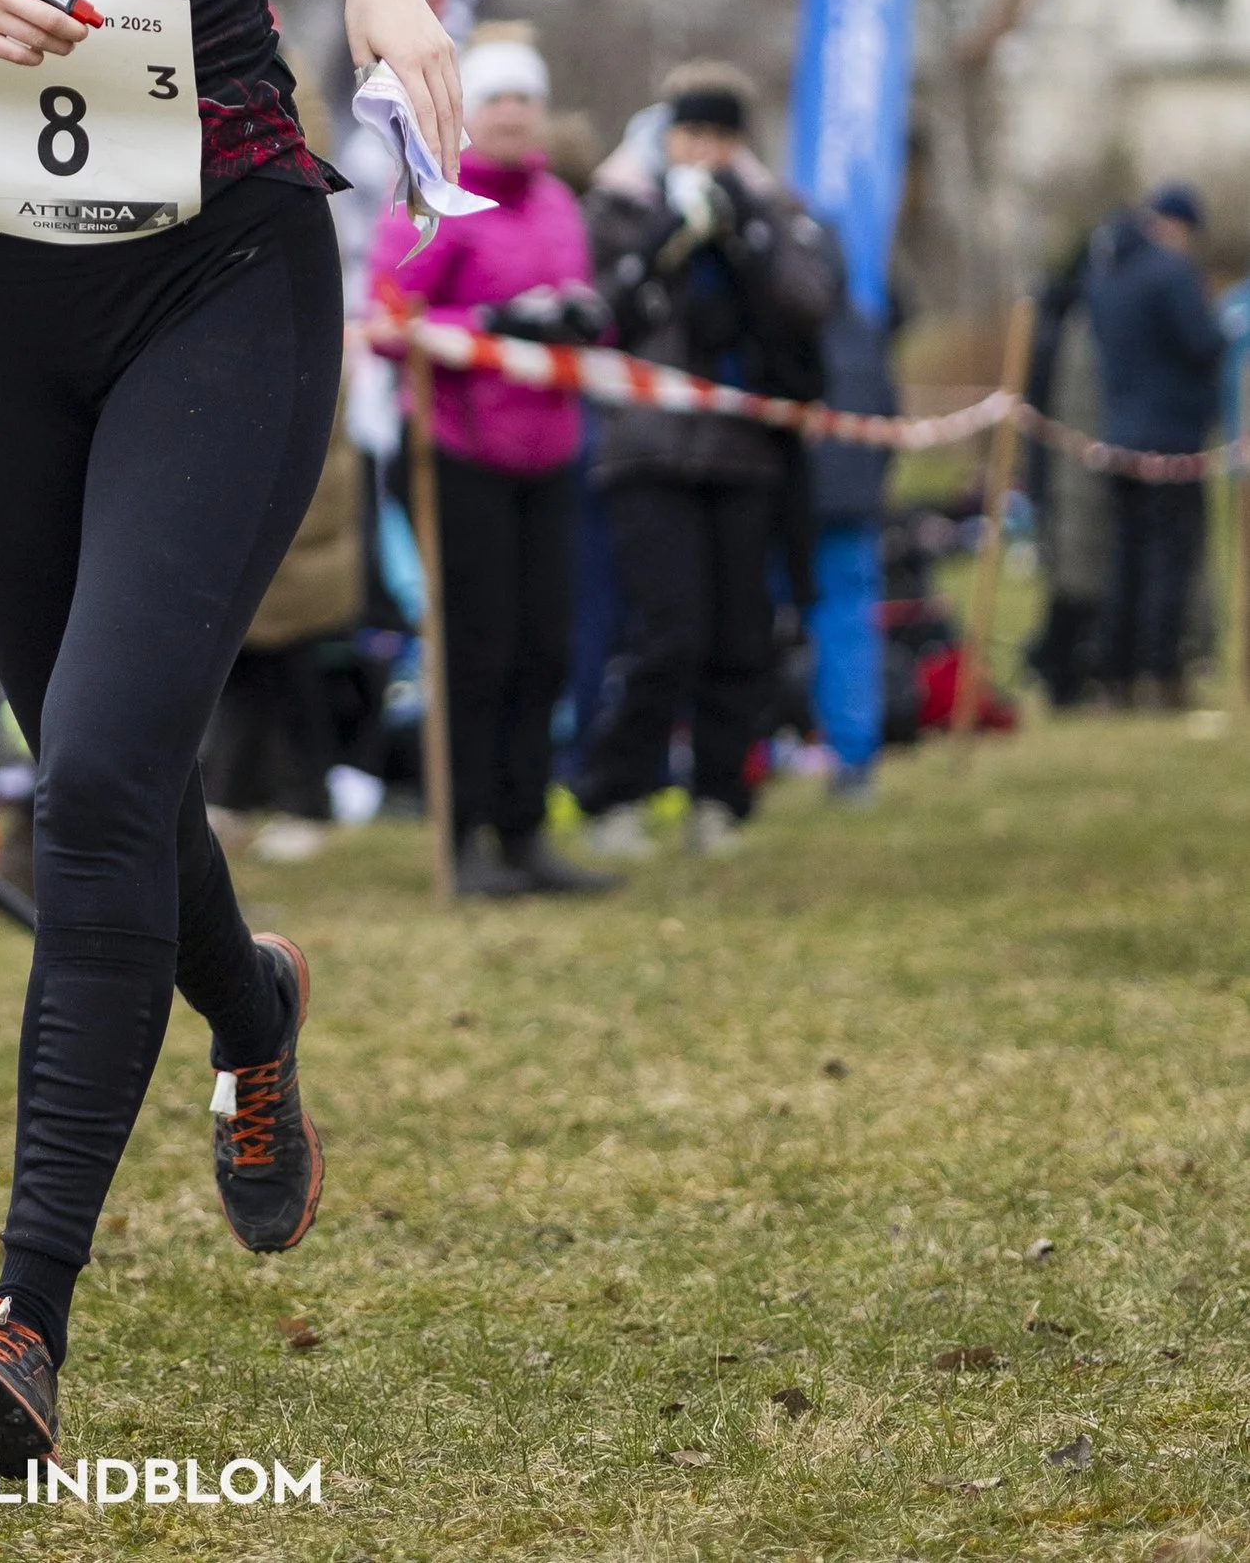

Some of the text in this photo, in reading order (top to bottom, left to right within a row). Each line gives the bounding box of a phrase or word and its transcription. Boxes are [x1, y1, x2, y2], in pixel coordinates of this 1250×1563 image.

[121, 15, 162, 33] 2025
[146, 64, 179, 100] 3
[37, 85, 90, 176] 8
[32, 220, 119, 232] ORIENTERING
